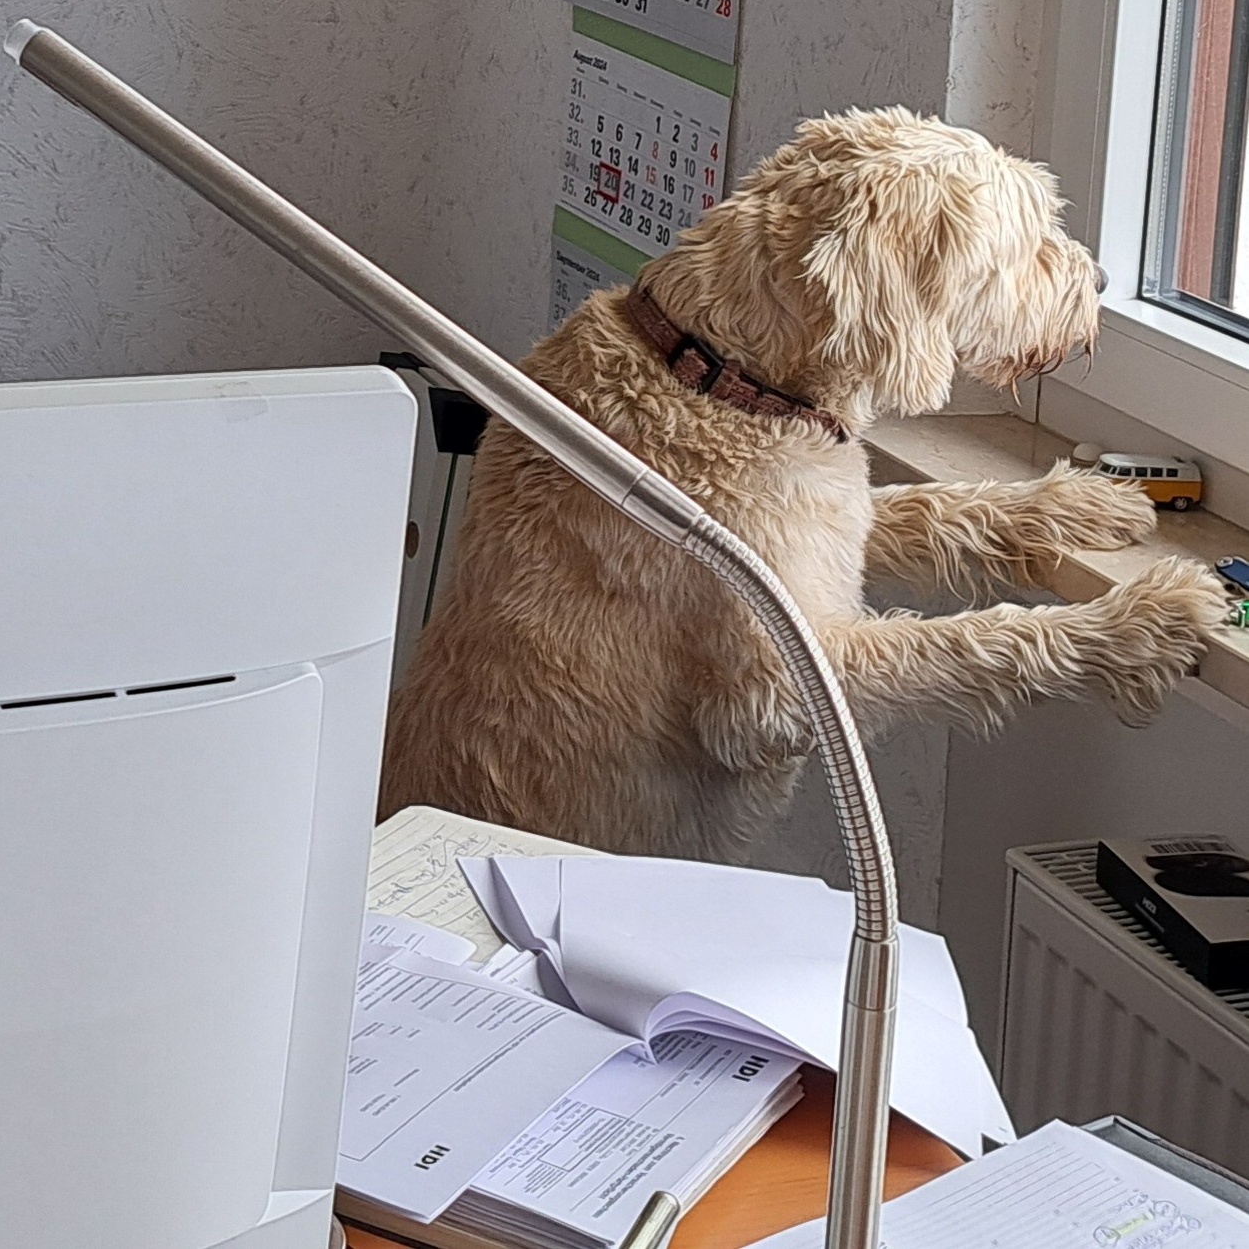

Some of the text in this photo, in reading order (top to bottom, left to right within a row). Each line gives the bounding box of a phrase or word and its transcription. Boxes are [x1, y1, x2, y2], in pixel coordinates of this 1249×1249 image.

[569, 103, 584, 124] 32.
[597, 115, 604, 133] 5
[616, 123, 623, 142] 6
[635, 132, 642, 150] 7
[670, 150, 677, 168] 9
[684, 157, 695, 177] 10
[704, 167, 715, 187] 11
[571, 78, 718, 162] 31. 1 2 3 4
[565, 151, 579, 172] 34.
[589, 163, 600, 182] 19
[604, 171, 618, 191] 20
[623, 180, 635, 200] 21
[640, 189, 654, 210] 22
[658, 199, 673, 220] 23
[566, 127, 582, 148] 33.
[591, 138, 602, 158] 12
[609, 147, 620, 166] 13
[627, 156, 639, 176] 14
[663, 174, 674, 194] 16
[683, 184, 694, 204] 17
[562, 175, 577, 197] 35.
[584, 187, 597, 207] 26
[601, 197, 615, 216] 27
[619, 205, 633, 226] 28
[637, 215, 651, 236] 29
[656, 224, 670, 246] 30
[556, 279, 570, 302] 36.
[733, 1055, 769, 1082] HDI
[414, 1143, 450, 1172] HDI
